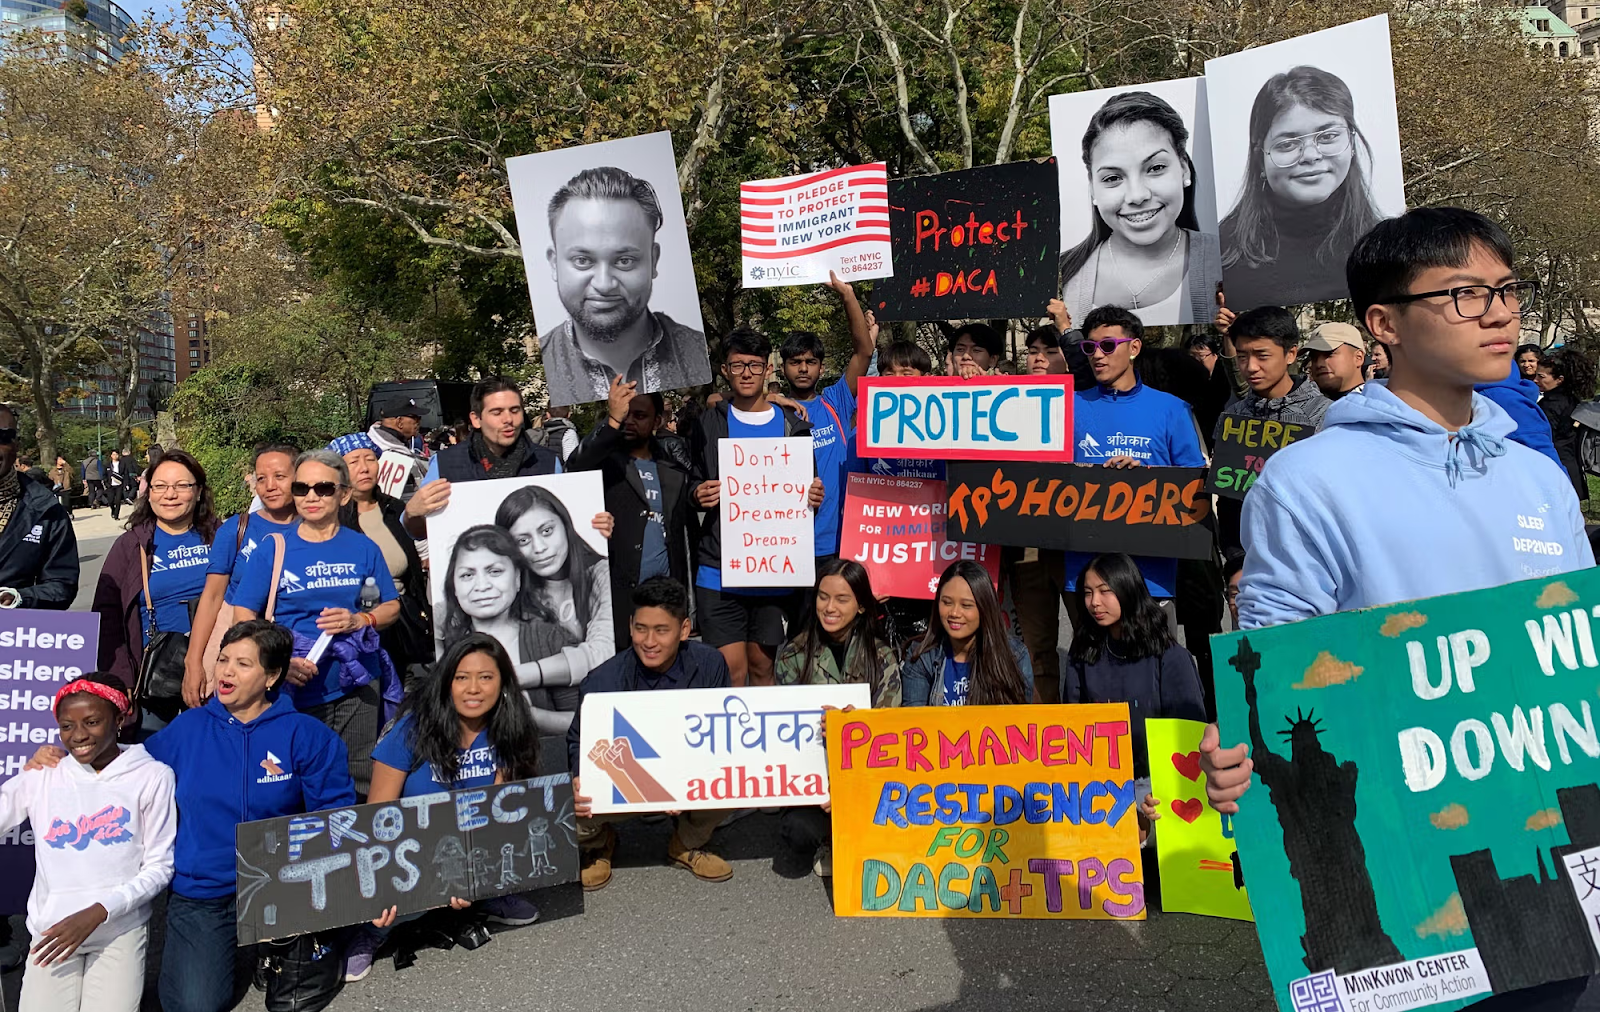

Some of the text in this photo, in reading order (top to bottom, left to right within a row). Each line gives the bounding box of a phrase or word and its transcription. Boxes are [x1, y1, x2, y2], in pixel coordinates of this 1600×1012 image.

[788, 180, 844, 204] I PLEDGE
[778, 192, 855, 220] TO PROTECT
[778, 207, 855, 233] IMMIGRANT
[915, 209, 1029, 254] Protect
[781, 221, 851, 246] NEW YORK
[840, 252, 882, 265] Text NYIC
[841, 261, 883, 274] to 864237
[766, 262, 800, 281] nyic
[910, 268, 999, 298] #DACA
[872, 387, 1065, 444] PROTECT
[1107, 432, 1152, 448] अधिकार
[733, 443, 791, 467] Don't
[1105, 447, 1152, 459] adhikaar
[1245, 455, 1265, 472] TO
[727, 475, 805, 502] Destroy
[850, 475, 923, 489] Text NYIC to 864237
[729, 502, 807, 523] Dreamers
[862, 504, 903, 518] NEW
[949, 468, 1212, 535] TPS HOLDERS
[743, 532, 797, 547] Dreams
[859, 524, 882, 535] FOR
[167, 544, 212, 560] अधिका
[854, 540, 987, 563] JUSTICE!
[305, 560, 357, 577] अधिकार
[306, 577, 361, 589] adhikaar
[1406, 628, 1491, 700] UP
[841, 720, 1129, 772] PERMANENT
[1398, 700, 1600, 792] DOWN
[256, 772, 293, 785] adhikaar
[686, 764, 831, 802] adhika
[873, 779, 1136, 829] RESIDENCY
[287, 774, 571, 862] PROTECT
[926, 826, 1010, 865] FOR
[278, 838, 421, 910] TPS
[862, 856, 1146, 918] DACA+TPS
[1349, 974, 1477, 1012] For Community Action
